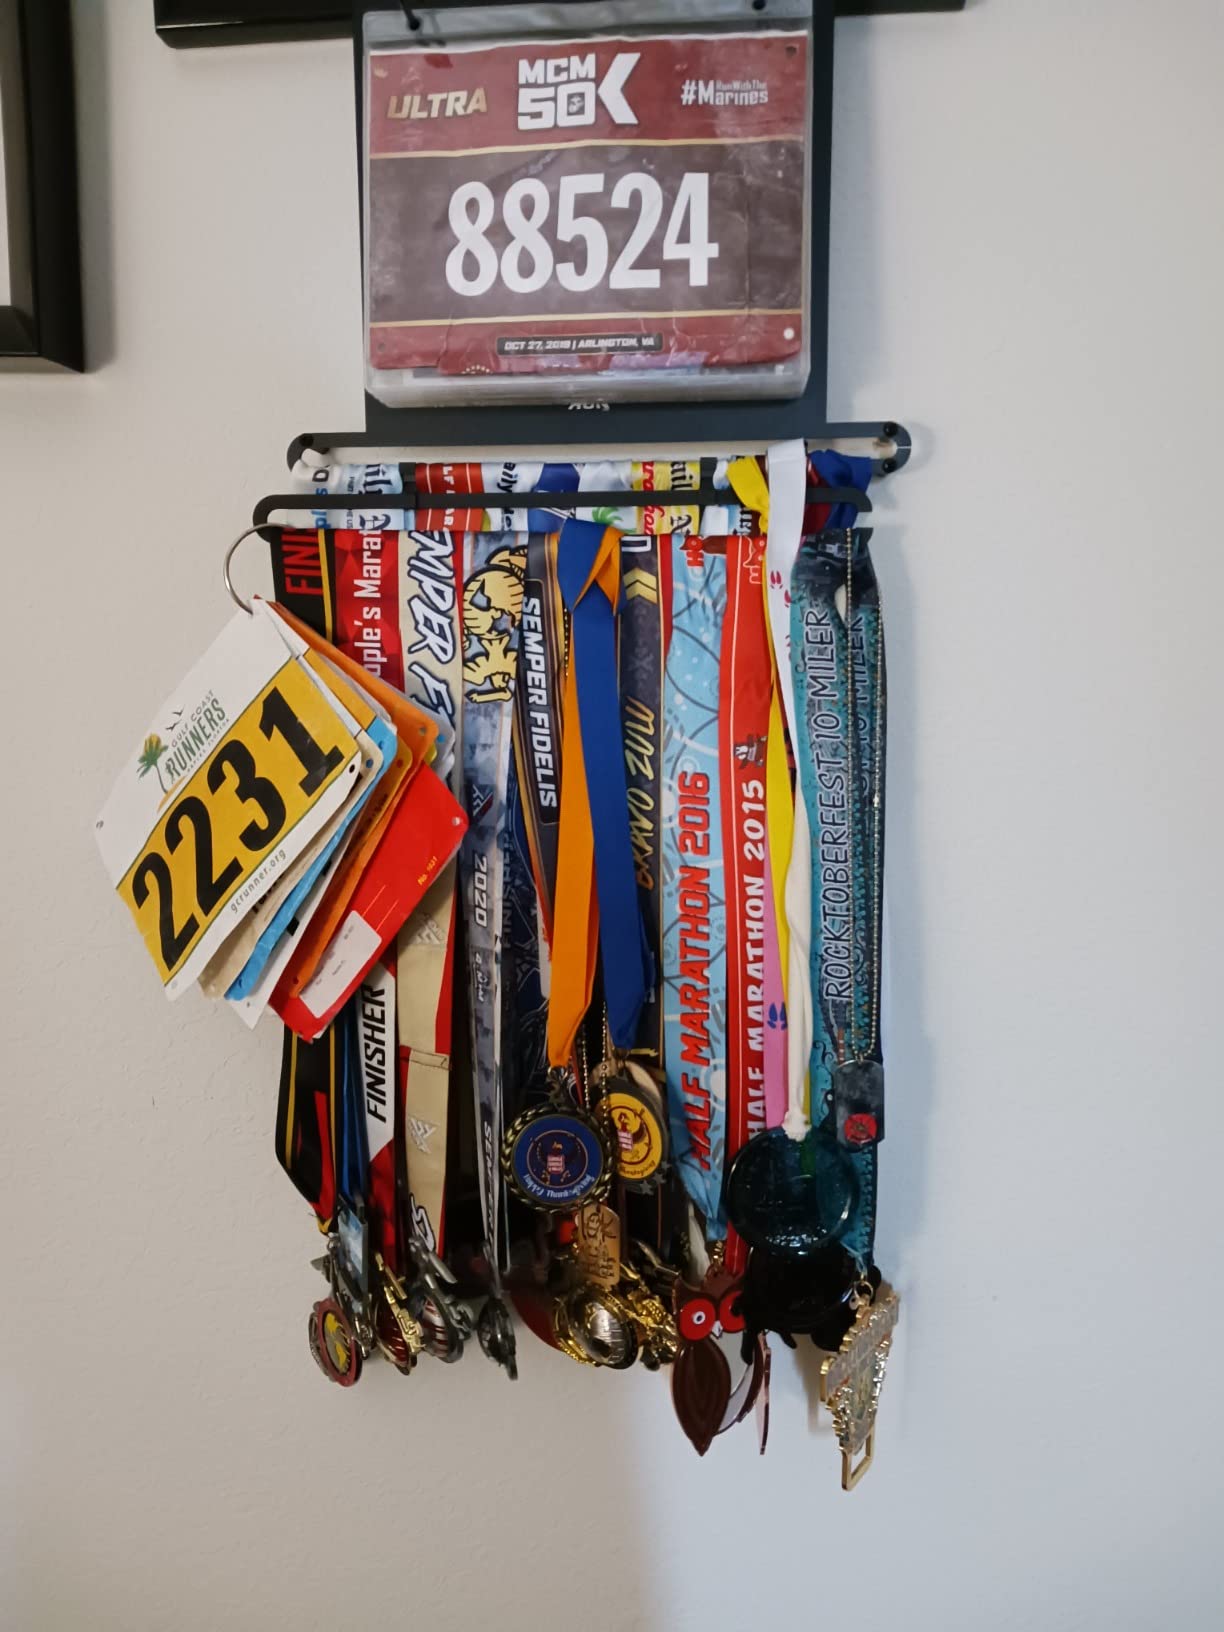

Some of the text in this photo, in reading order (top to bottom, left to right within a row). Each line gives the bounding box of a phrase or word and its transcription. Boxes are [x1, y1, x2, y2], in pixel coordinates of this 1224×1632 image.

[387, 88, 488, 119] ULTRA
[518, 53, 596, 86] MCM
[445, 172, 719, 296] 88524
[504, 341, 525, 350] OCT
[578, 338, 638, 349] ARLINGTON,
[641, 336, 655, 346] VA
[165, 698, 226, 780] RUNNERS
[171, 689, 214, 748] GULF COAST
[522, 597, 558, 809] SEMPER FIDELIS
[624, 696, 655, 781] ZULU
[132, 686, 345, 972] 2231
[742, 779, 765, 861] 2015
[805, 610, 853, 1001] ROCKTOBERFEST 10 MILER
[230, 849, 287, 914] gcrunner.org
[474, 853, 488, 928] 2020
[678, 770, 712, 1172] HALF MARATHON 2016
[745, 874, 766, 1052] MARATHON
[361, 981, 387, 1123] FINISHER
